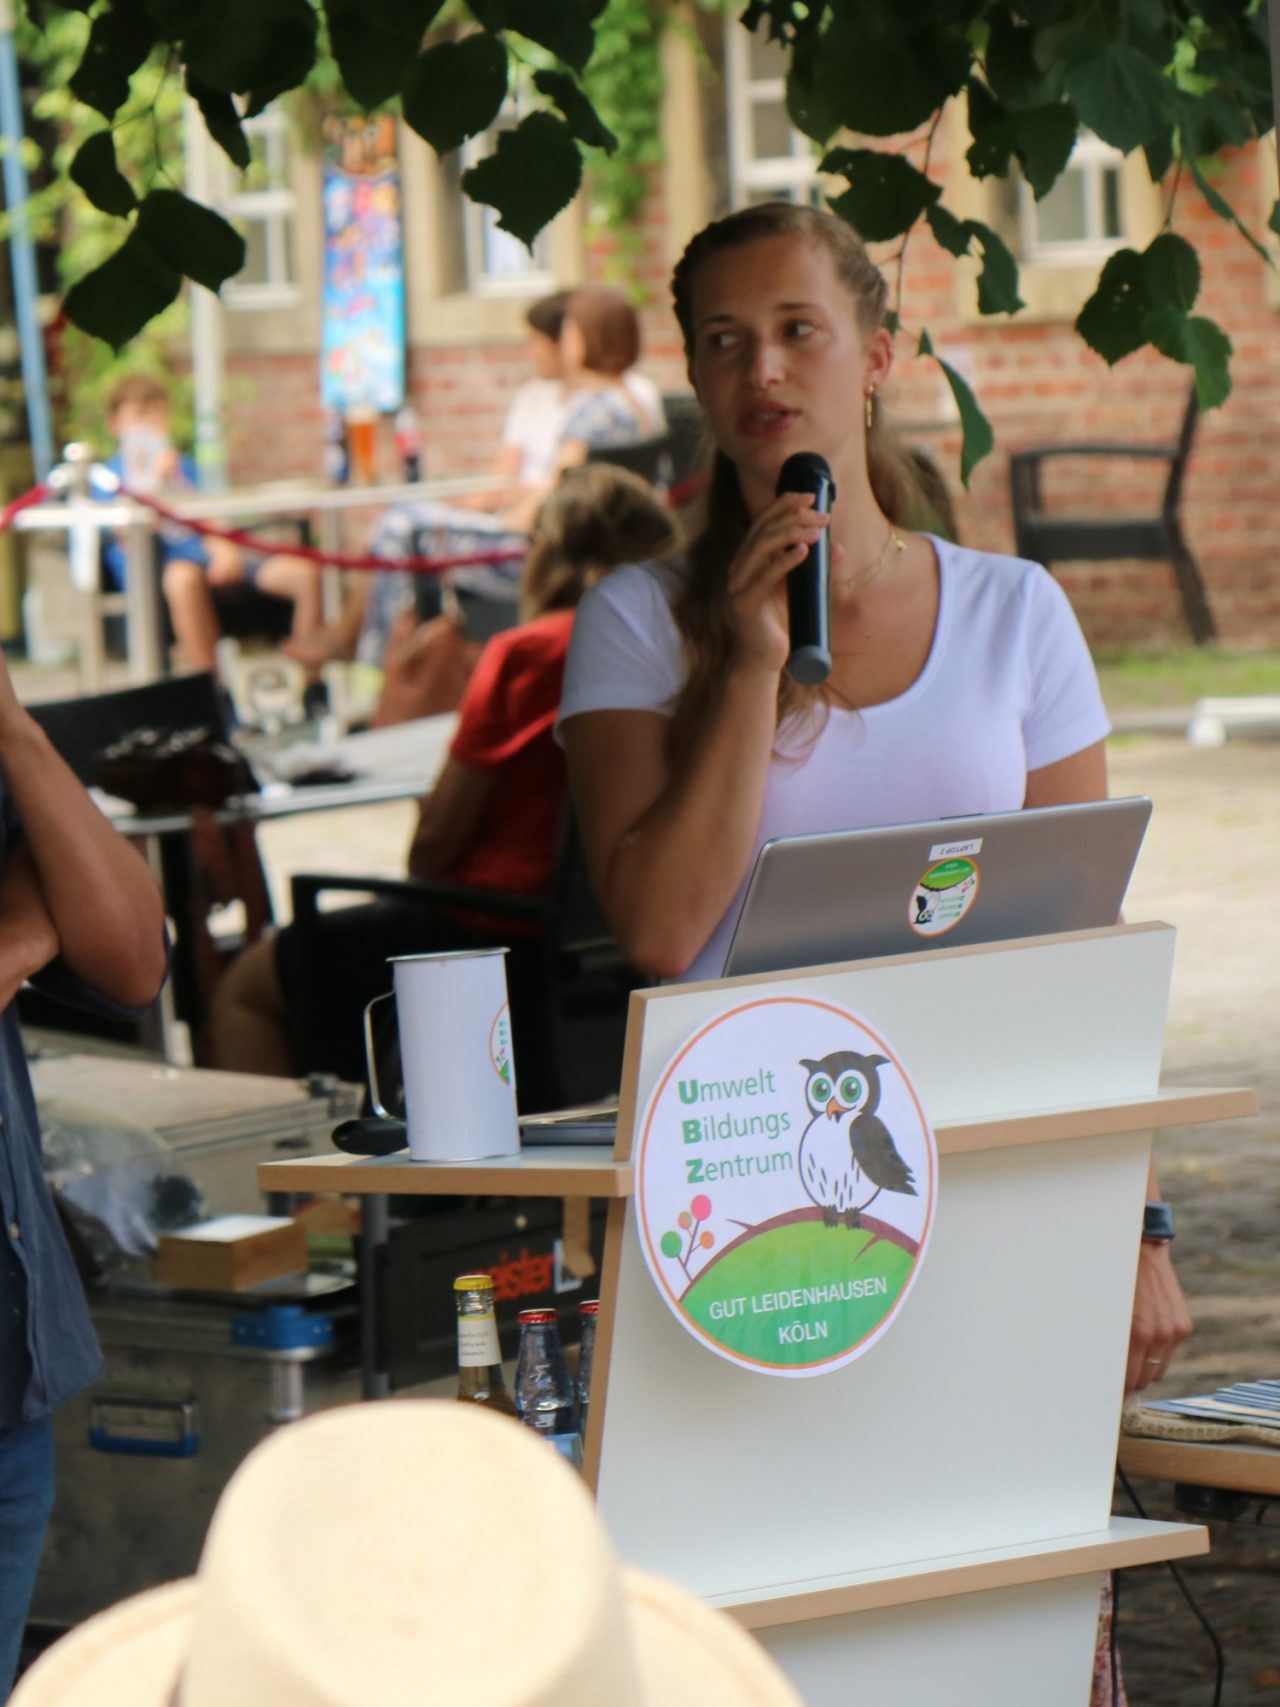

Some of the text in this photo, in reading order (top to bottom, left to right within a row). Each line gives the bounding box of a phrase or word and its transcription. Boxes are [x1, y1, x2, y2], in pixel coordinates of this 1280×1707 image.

[678, 1068, 776, 1105] Umwelt
[682, 1112, 791, 1145] Bildungs
[686, 1151, 793, 1184] Zentrum
[709, 1276, 888, 1320] GUT LEIDENHAUSEN
[778, 1320, 829, 1345] KÖLN
